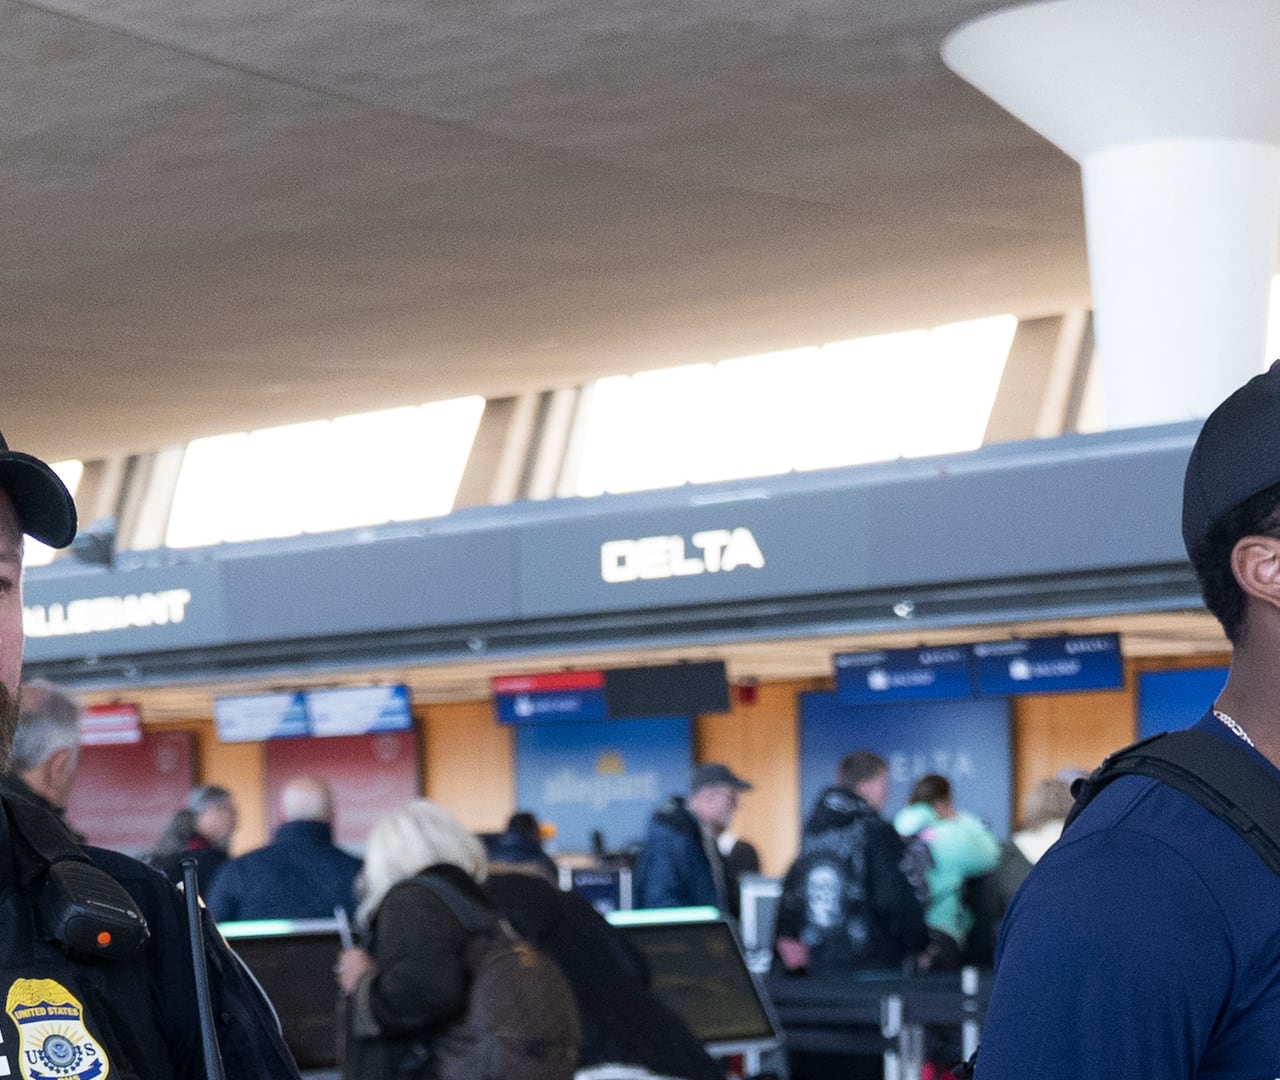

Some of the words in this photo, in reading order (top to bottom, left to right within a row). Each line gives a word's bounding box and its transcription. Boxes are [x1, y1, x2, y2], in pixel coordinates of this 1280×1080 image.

[601, 527, 766, 583] DELTA
[14, 1008, 47, 1019] UNITED
[47, 1007, 79, 1016] STATES
[84, 1043, 96, 1056] S
